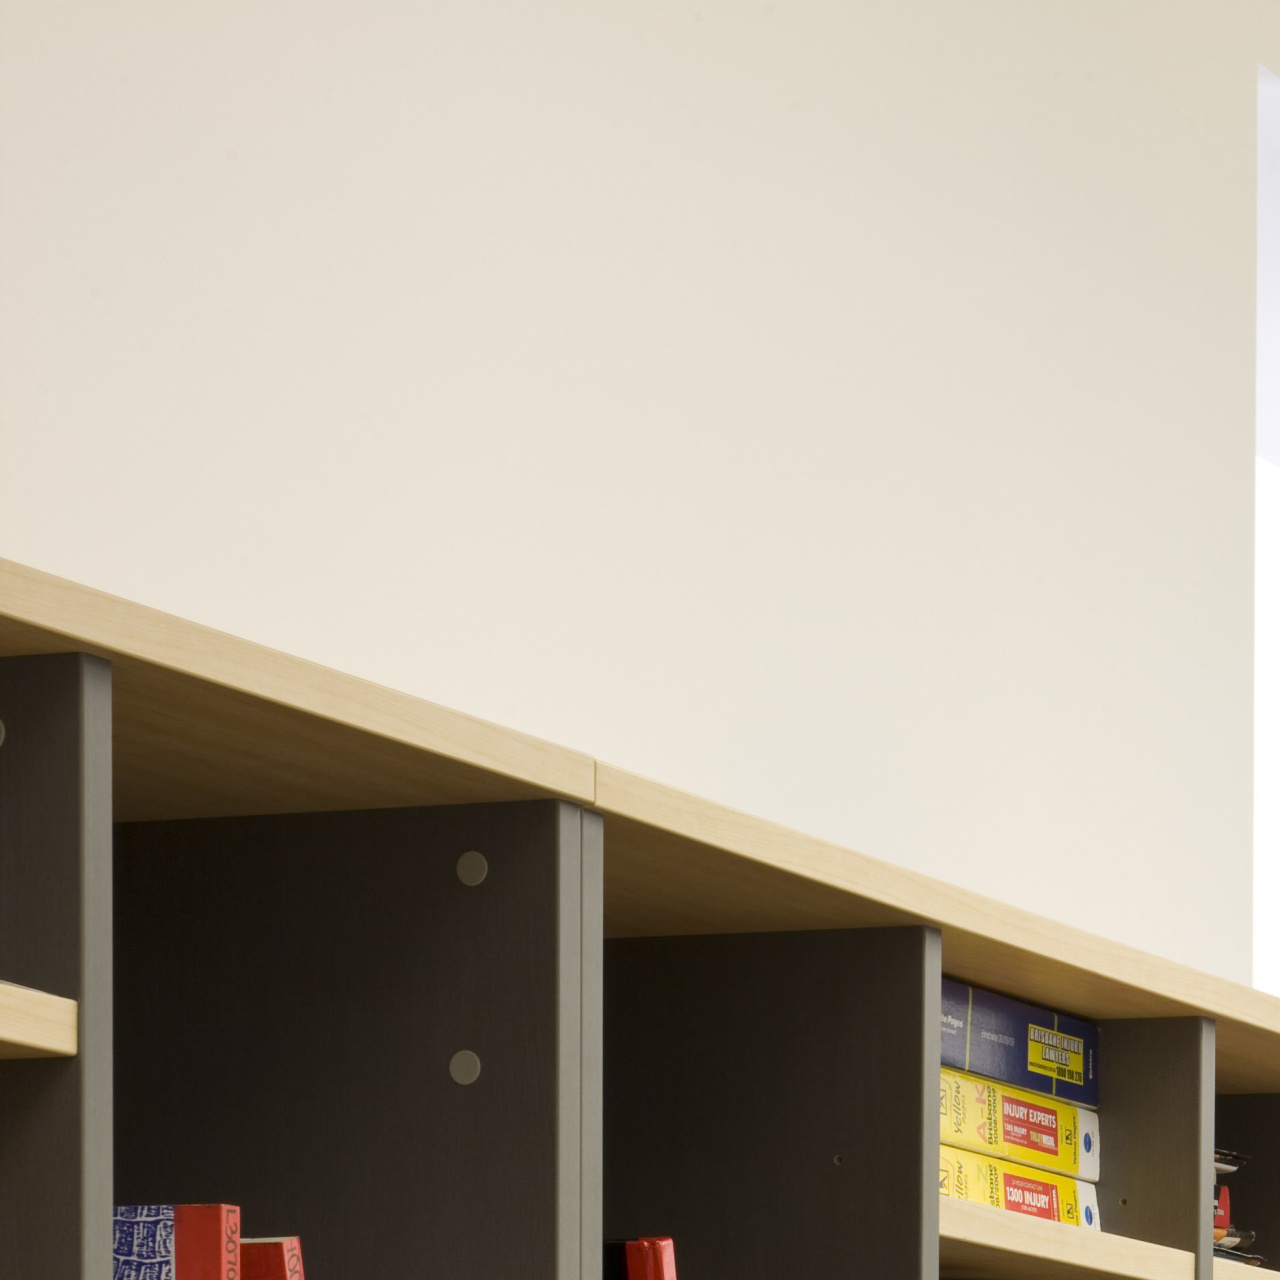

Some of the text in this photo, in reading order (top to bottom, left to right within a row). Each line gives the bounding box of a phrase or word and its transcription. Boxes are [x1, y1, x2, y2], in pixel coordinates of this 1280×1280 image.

[1029, 1027, 1083, 1056] BRISBANE INJURY
[1041, 1046, 1071, 1067] LAWYERS
[952, 1080, 964, 1134] Yellow
[1003, 1101, 1057, 1129] INJURY EXPERTS
[954, 1161, 964, 1199] llow
[1006, 1186, 1024, 1203] 1300
[1023, 1191, 1050, 1210] INJURY
